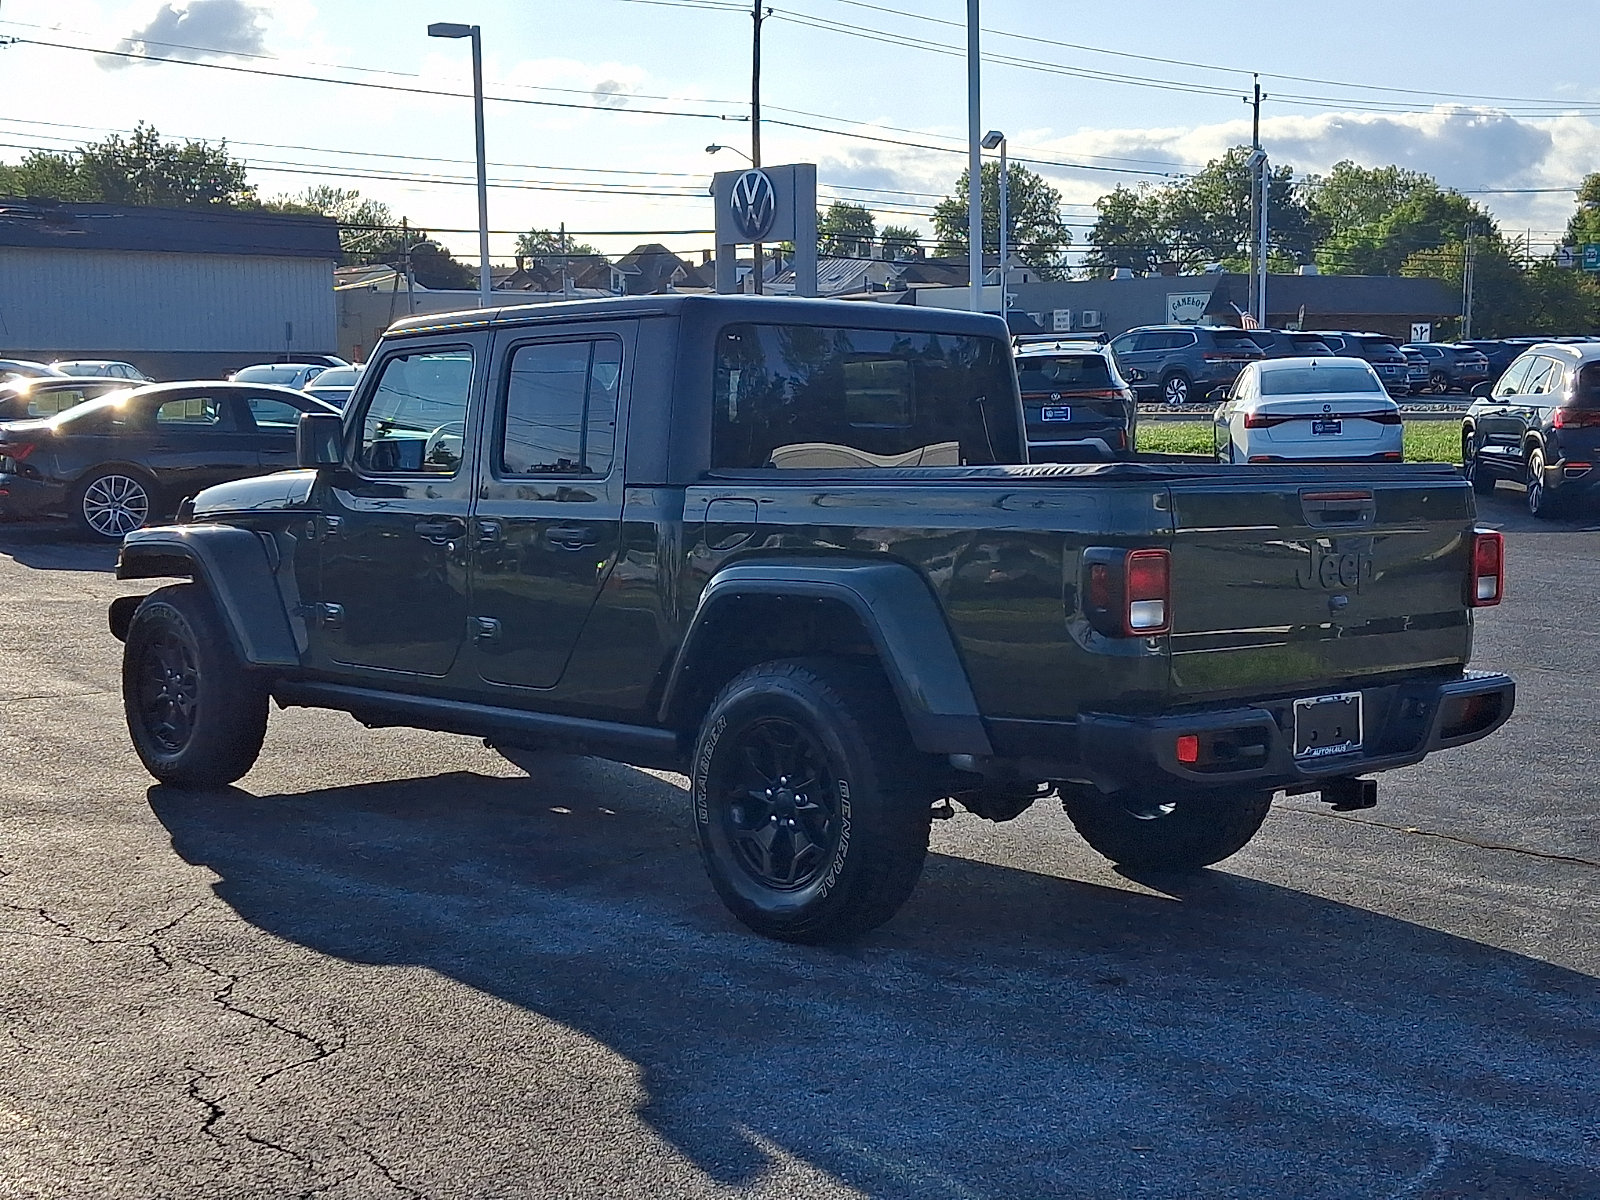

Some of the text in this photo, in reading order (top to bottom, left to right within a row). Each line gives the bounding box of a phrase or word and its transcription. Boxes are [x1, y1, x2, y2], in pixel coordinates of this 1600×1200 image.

[1296, 545, 1373, 595] Jeep
[698, 715, 727, 824] GRABBER
[1312, 745, 1346, 756] AUTOHAUS
[816, 779, 851, 898] GENERAL
